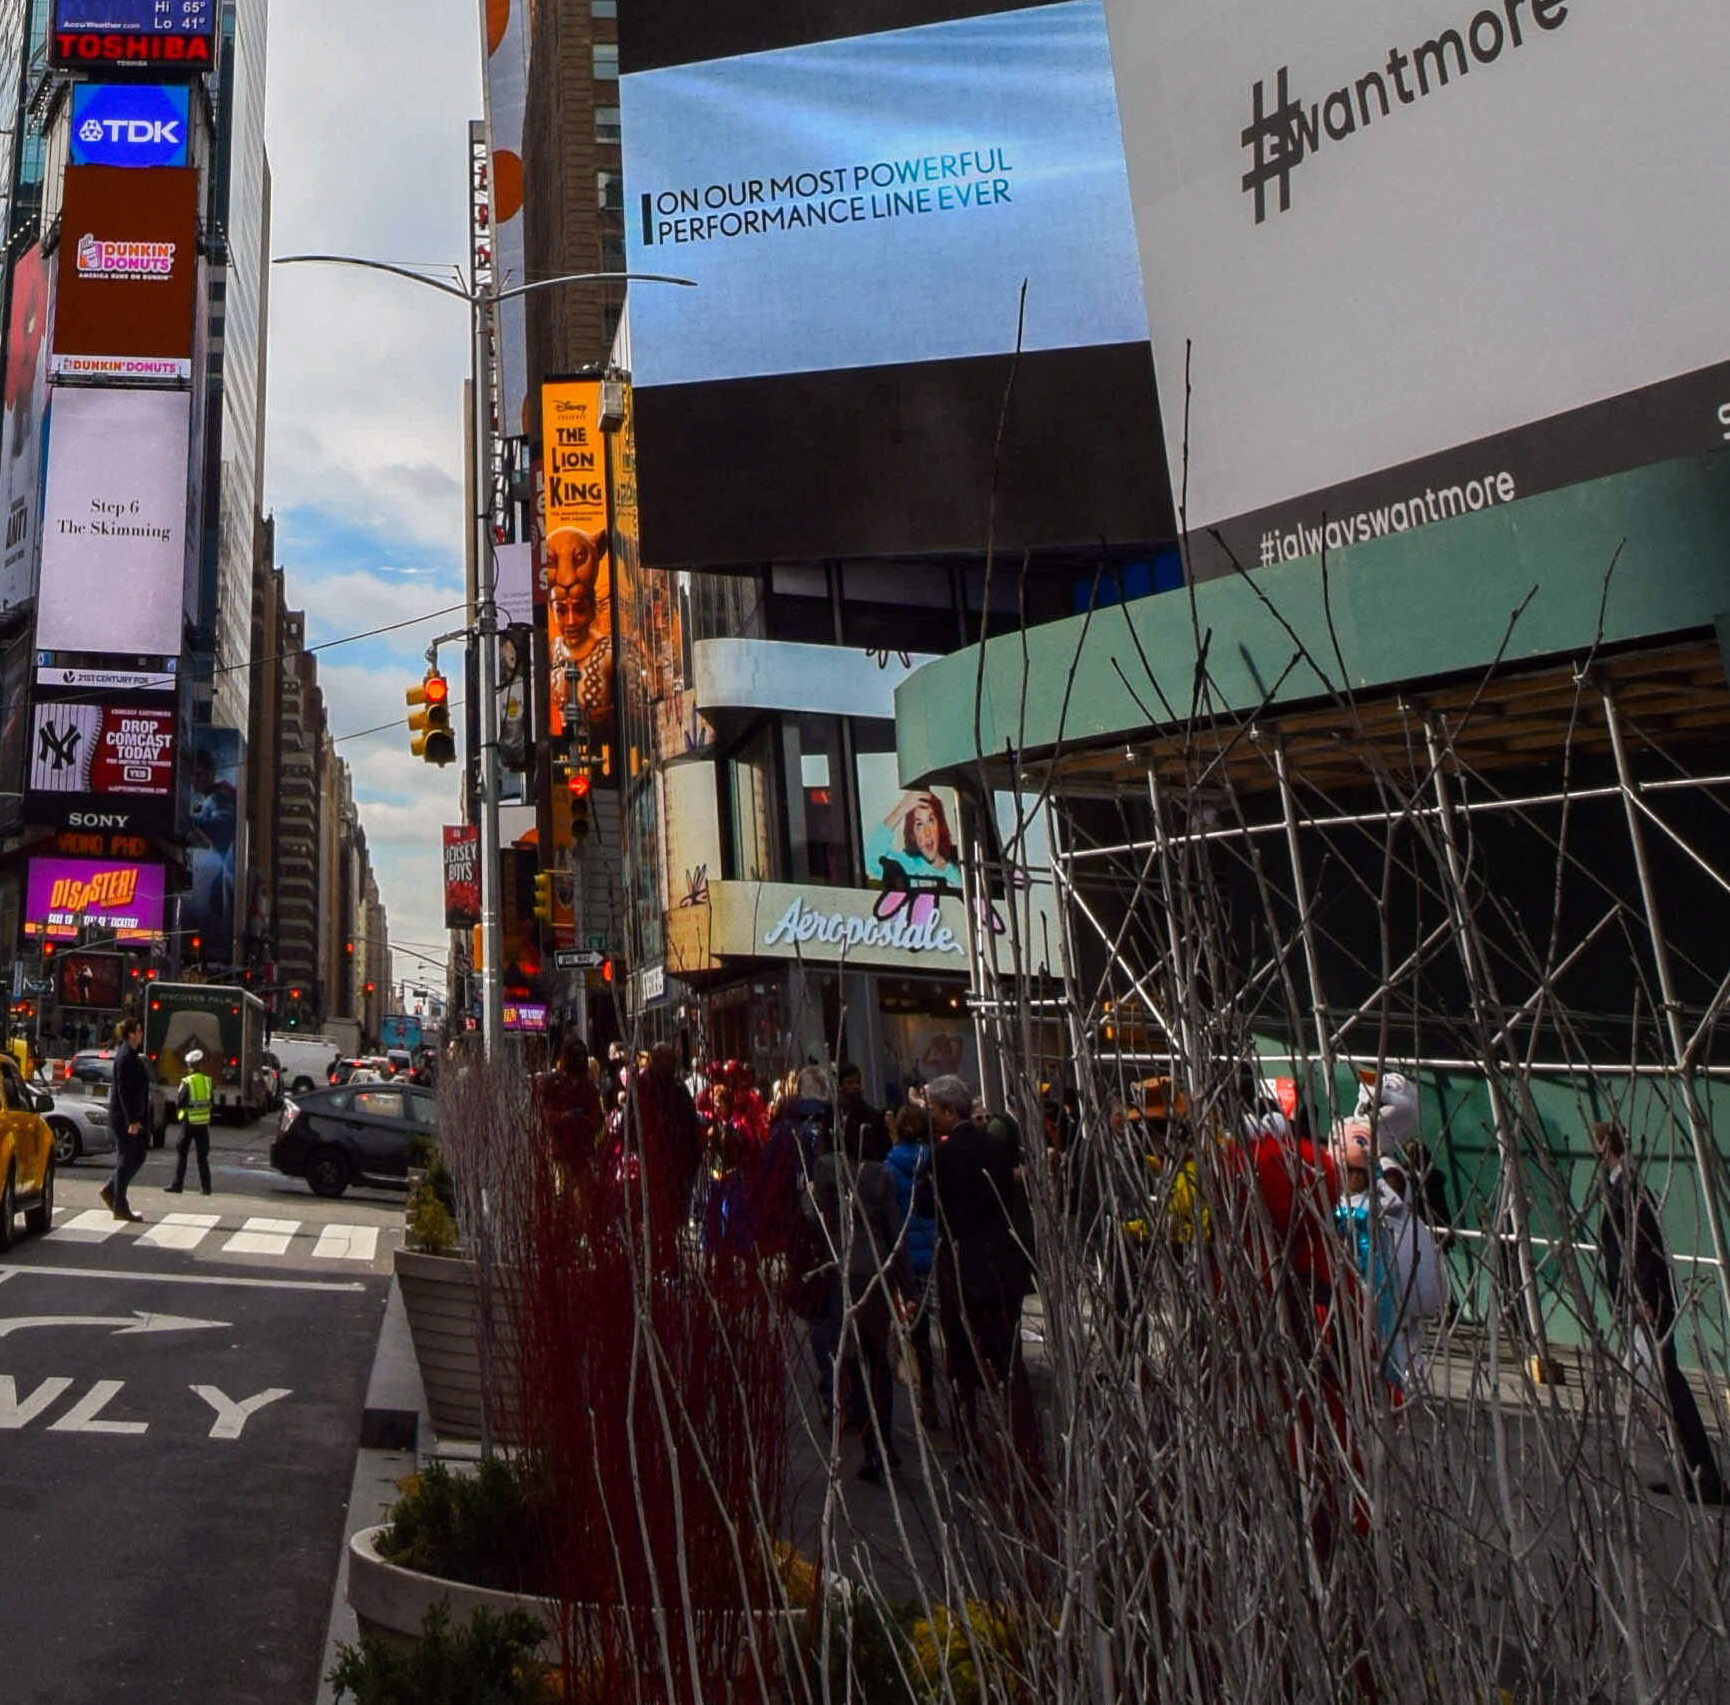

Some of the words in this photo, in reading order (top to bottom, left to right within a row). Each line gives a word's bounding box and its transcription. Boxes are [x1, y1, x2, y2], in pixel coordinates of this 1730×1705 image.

[154, 1, 170, 13] Hi
[154, 17, 173, 30] Lo
[56, 33, 212, 61] TOSHIBA
[102, 119, 180, 144] TDK
[656, 187, 699, 217] ON
[704, 178, 765, 211] OUR
[771, 167, 848, 202] MOST
[853, 147, 1014, 191] POWERFUL
[657, 195, 867, 245] PERFORMANCE
[871, 186, 933, 220] LINE
[938, 177, 1013, 211] EVER
[104, 243, 176, 257] DUNKIN'
[104, 257, 170, 271] DONUTS
[73, 359, 126, 373] DUNKIN'
[126, 361, 177, 375] DONUTS
[556, 426, 587, 443] THE
[552, 446, 595, 474] LION
[549, 475, 602, 508] KING
[90, 498, 125, 518] Step
[130, 499, 140, 514] 6
[58, 519, 86, 536] The
[90, 520, 172, 543] Skimming
[121, 718, 159, 734] DROP
[106, 732, 173, 749] COMCAST
[117, 745, 162, 761] TODAY
[69, 811, 130, 828] SONY
[444, 840, 478, 862] JERSEY
[448, 860, 473, 882] BOYS
[764, 895, 966, 957] Aéropostale
